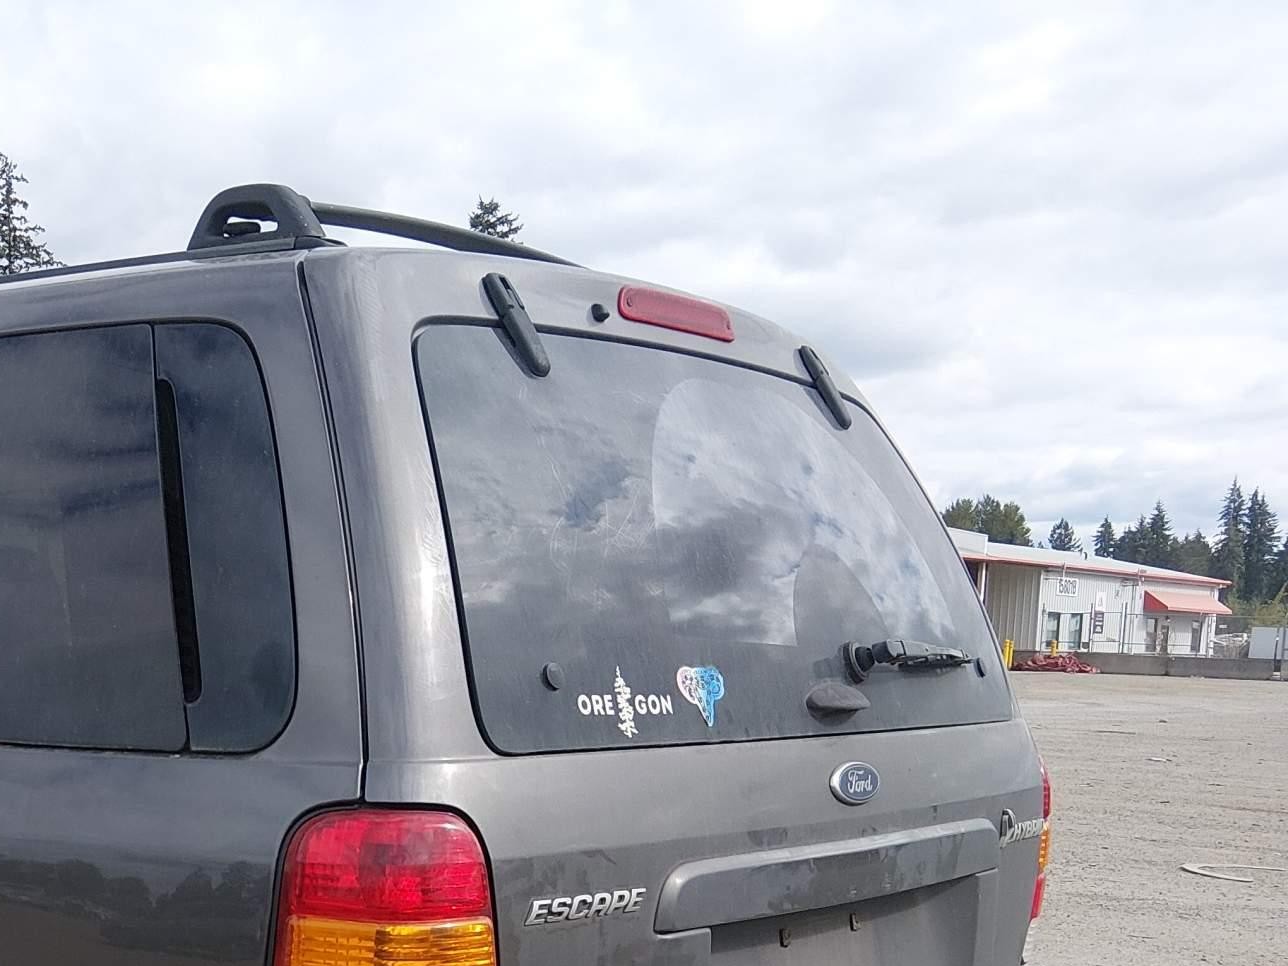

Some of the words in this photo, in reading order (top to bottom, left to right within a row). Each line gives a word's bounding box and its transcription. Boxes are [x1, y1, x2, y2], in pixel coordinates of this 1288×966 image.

[577, 694, 673, 716] OREGON
[847, 769, 873, 793] Ford
[524, 887, 647, 925] ESCAPE
